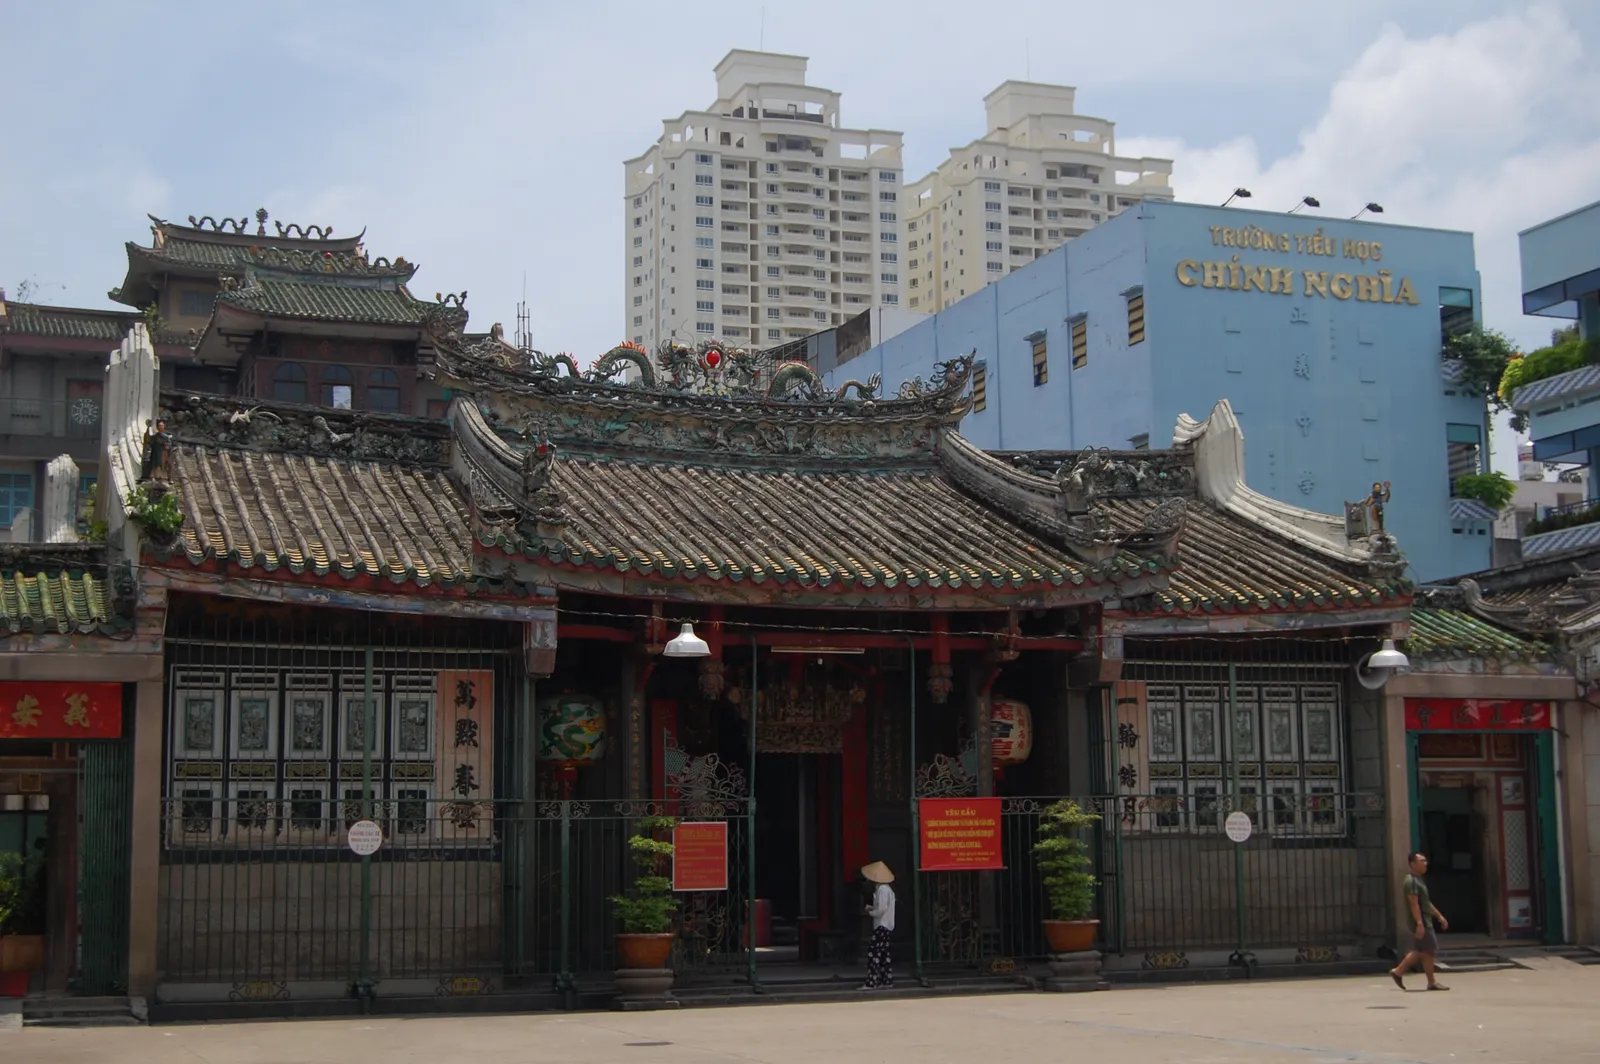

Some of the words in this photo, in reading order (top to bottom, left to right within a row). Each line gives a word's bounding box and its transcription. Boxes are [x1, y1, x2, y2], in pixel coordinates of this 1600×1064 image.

[1343, 239, 1383, 264] HỌC
[1176, 254, 1294, 295] CHÍNH
[1302, 269, 1421, 305] NGHĨA
